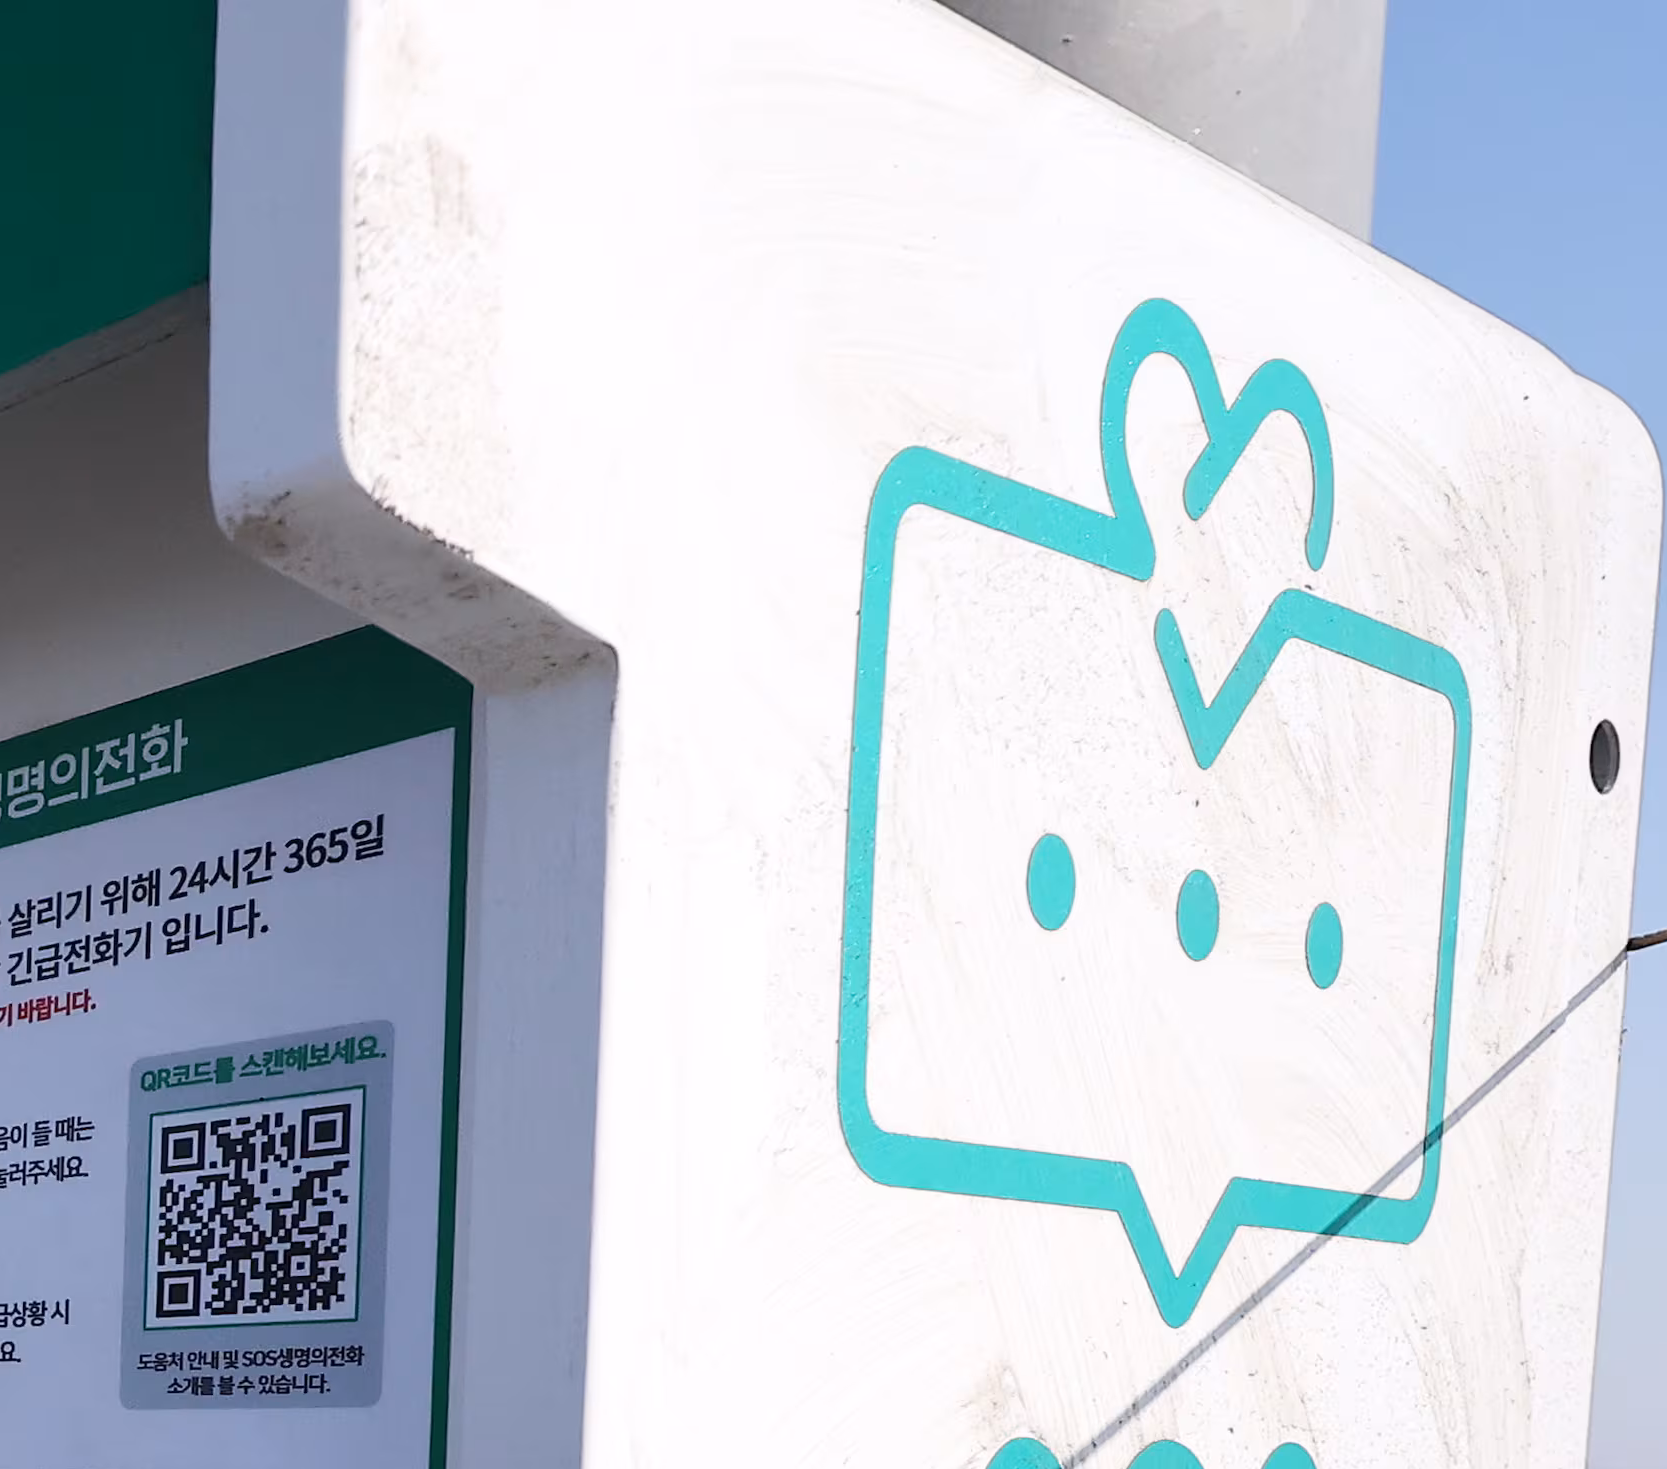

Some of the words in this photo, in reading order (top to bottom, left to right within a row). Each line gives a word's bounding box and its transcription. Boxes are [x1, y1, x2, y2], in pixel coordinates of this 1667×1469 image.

[7, 884, 92, 940] 살리기
[100, 868, 161, 916] 위해
[168, 841, 277, 900] 24시간
[283, 813, 385, 874] 365일
[7, 921, 152, 988] 긴급전화기
[162, 898, 269, 956] 입니다.
[17, 988, 97, 1024] 바랍니다.
[140, 1056, 236, 1092] QR코드를
[239, 1035, 387, 1078] 스캔해보세요.
[31, 1120, 53, 1147] 들
[55, 1116, 95, 1143] 때는
[51, 1298, 71, 1326] 시
[137, 1351, 184, 1372] 도움처
[187, 1350, 220, 1371] 안내
[223, 1349, 239, 1370] 및
[167, 1376, 215, 1396] 소개를
[237, 1376, 256, 1395] 수
[258, 1373, 331, 1395] 있습니다.
